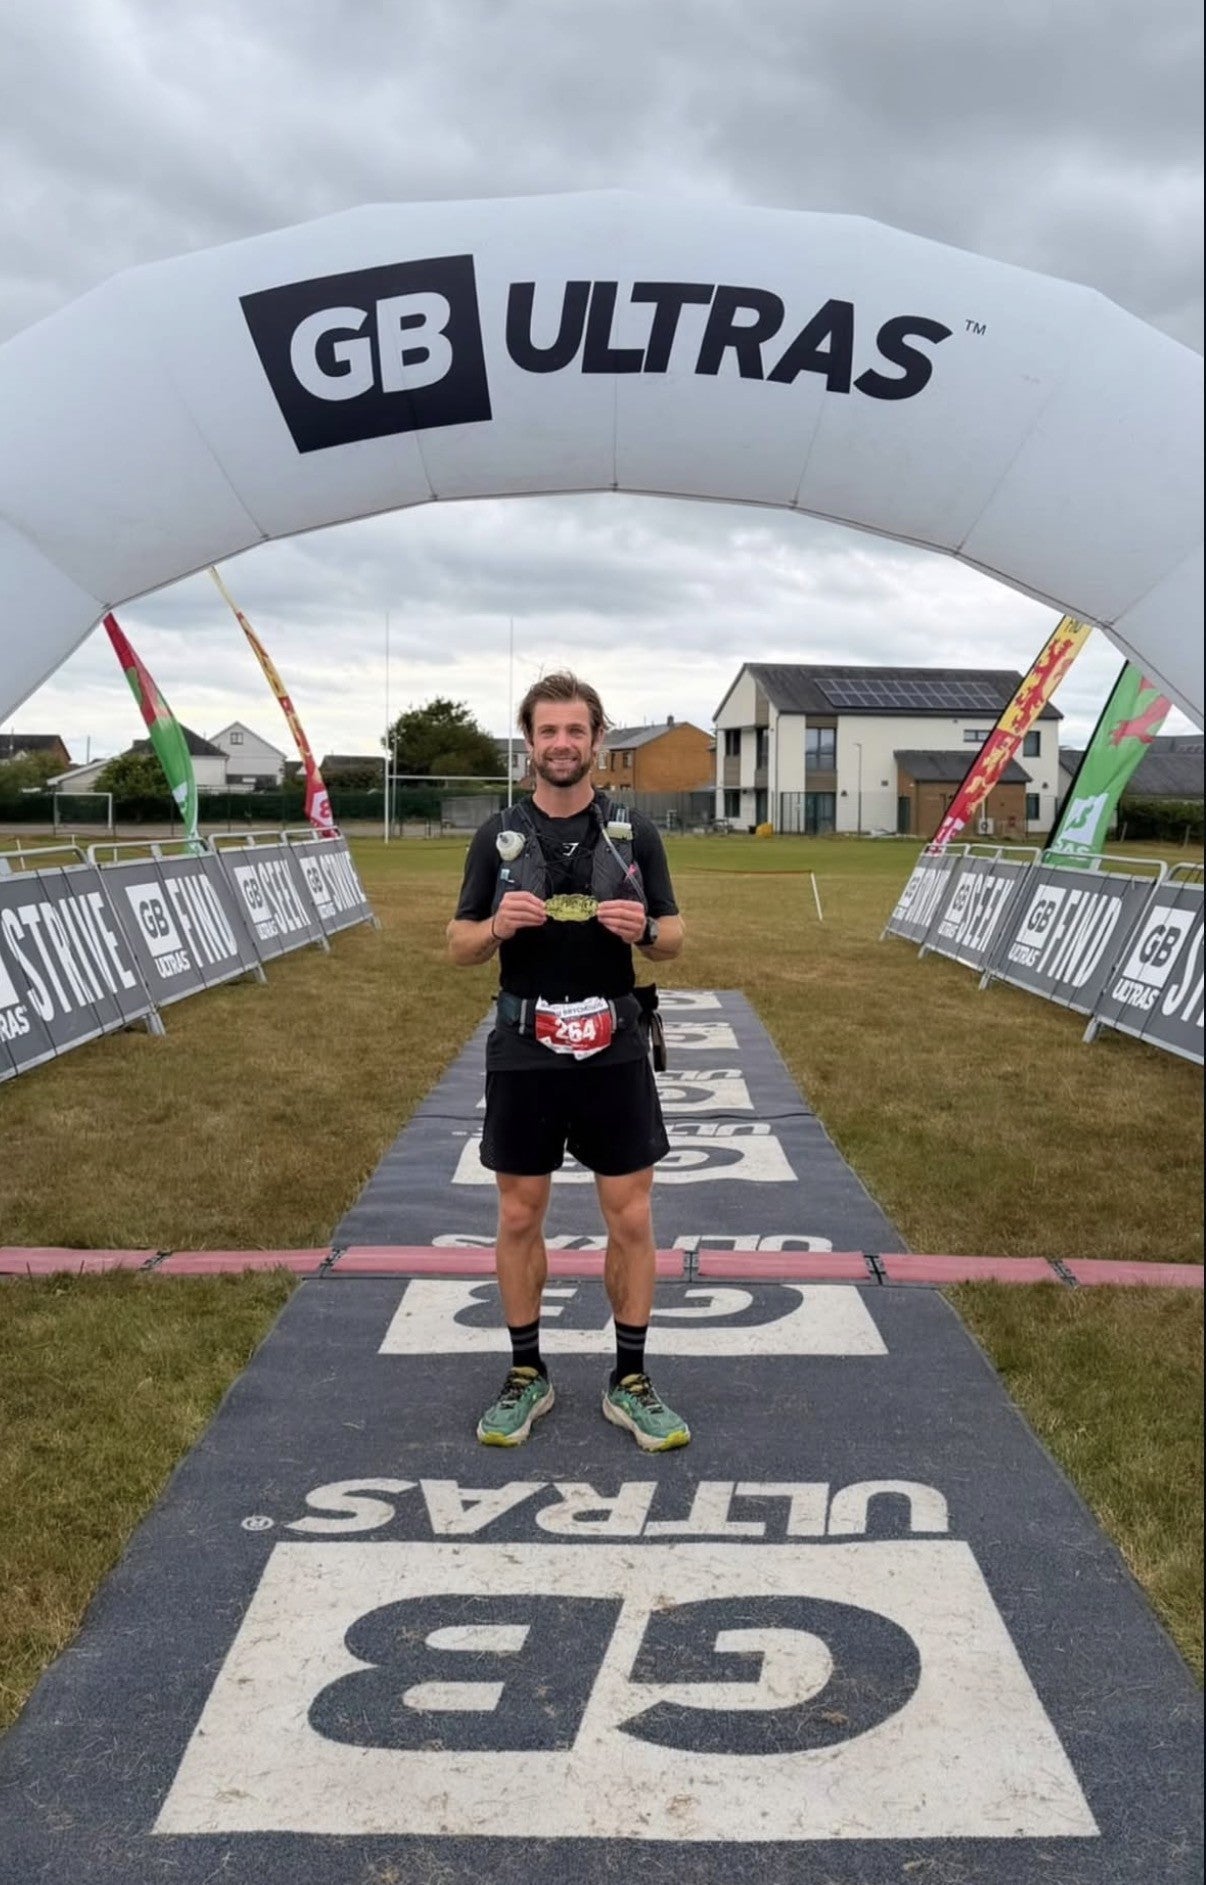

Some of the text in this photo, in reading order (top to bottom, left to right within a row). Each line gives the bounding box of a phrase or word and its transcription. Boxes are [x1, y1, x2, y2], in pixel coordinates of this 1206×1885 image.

[290, 291, 453, 401] GB
[505, 281, 952, 400] ULTRAS
[139, 898, 170, 939] GB
[243, 878, 263, 910] GB
[258, 859, 311, 934] SEEK
[955, 873, 1015, 953] SEEK
[1027, 899, 1057, 934] GB
[164, 873, 238, 968] FIND
[1035, 888, 1123, 988] FIND
[1139, 924, 1182, 968] GB
[0, 892, 137, 1022] STRIVE
[154, 950, 191, 979] ULTRAS
[1008, 942, 1041, 968] ULTRAS
[1112, 977, 1161, 1011] ULTRAS
[555, 1018, 597, 1043] 264
[284, 1478, 949, 1537] ULTRAS
[308, 1595, 922, 1756] GB
